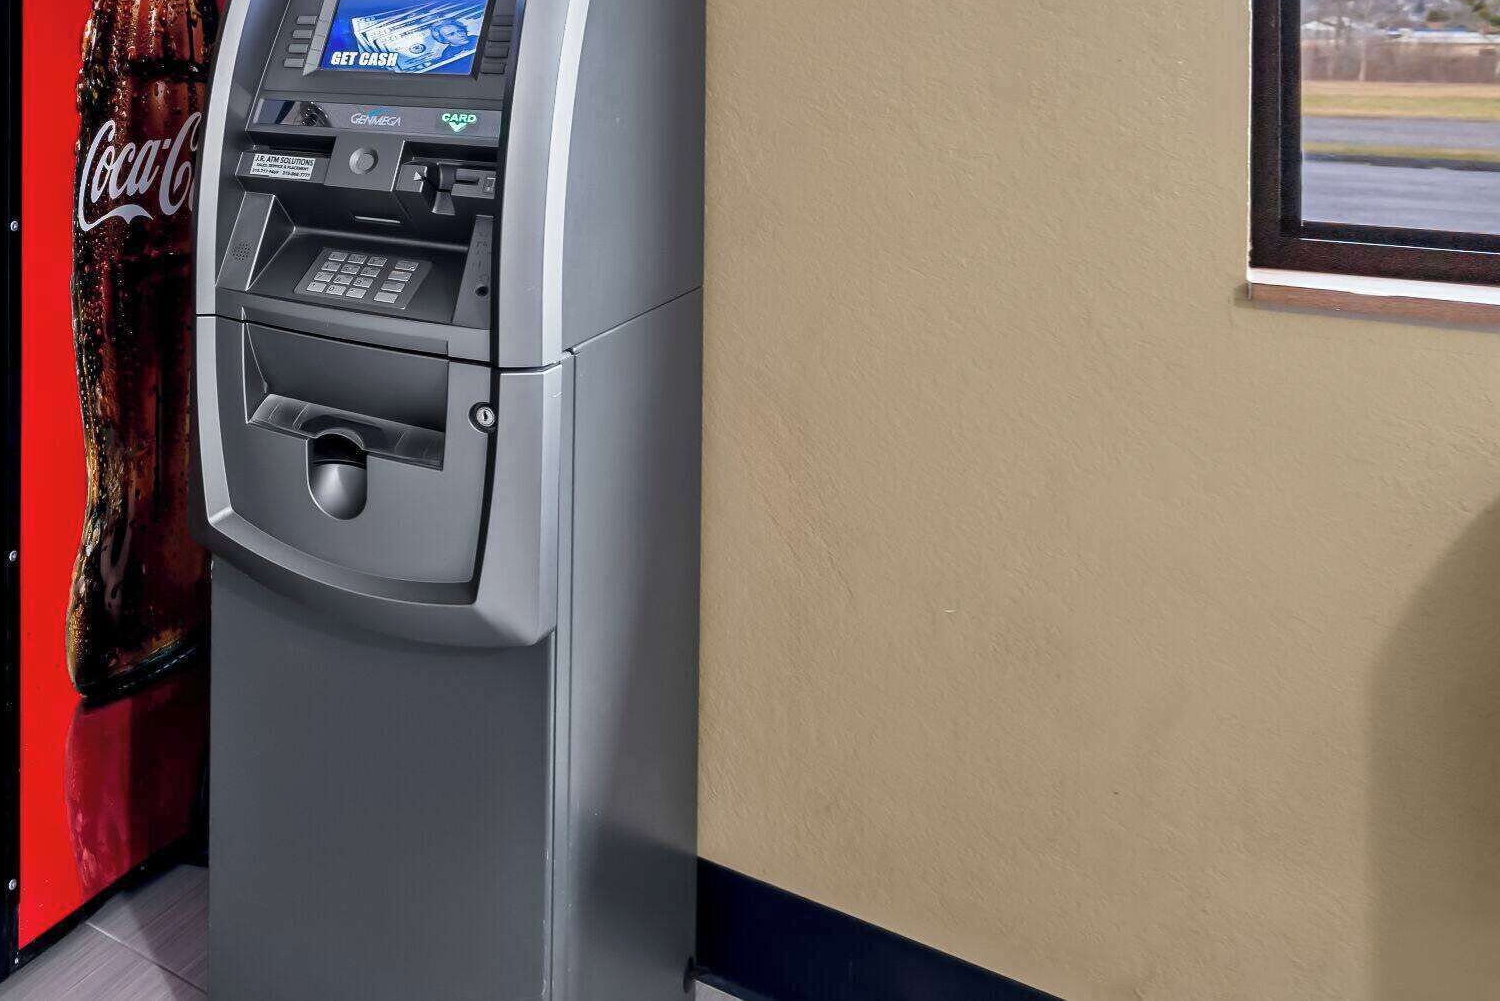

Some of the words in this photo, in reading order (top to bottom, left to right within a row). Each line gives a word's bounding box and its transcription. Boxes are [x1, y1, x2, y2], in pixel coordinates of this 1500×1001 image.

[330, 52, 357, 67] GET
[358, 51, 398, 67] CASH
[351, 113, 401, 126] GENMEGA
[441, 113, 478, 124] CARD
[280, 157, 315, 166] SOLUTIONS
